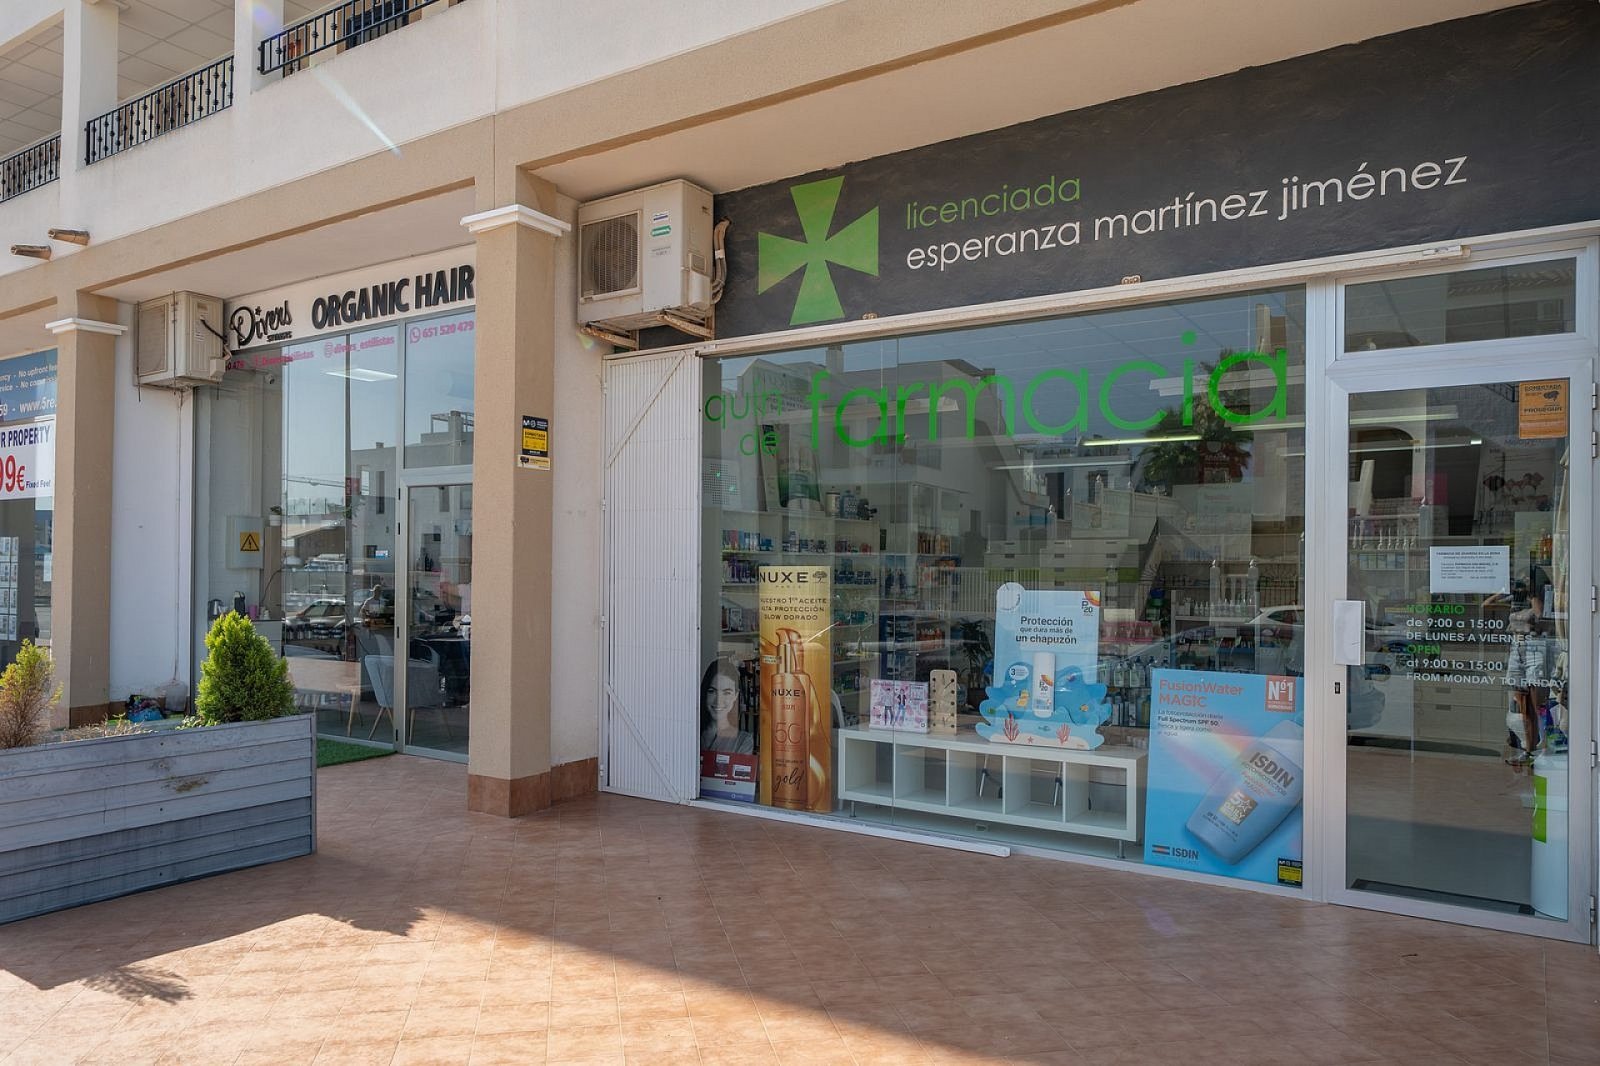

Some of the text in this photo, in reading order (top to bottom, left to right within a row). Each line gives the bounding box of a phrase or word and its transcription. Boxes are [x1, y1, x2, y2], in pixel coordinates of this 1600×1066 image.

[906, 175, 1081, 230] licenciada
[906, 155, 1468, 271] esperanza martínez jiménez
[312, 264, 476, 330] ORGANIC HAIR
[422, 326, 438, 338] 651
[806, 330, 1288, 450] farmacia
[8, 425, 50, 447] PROPERTY
[740, 424, 781, 456] de
[758, 571, 809, 584] NUXE
[1406, 604, 1465, 616] HORARIO
[1020, 614, 1074, 627] Protección
[1406, 617, 1504, 630] de 9:00 a 15:00
[1019, 626, 1032, 634] que
[1406, 631, 1533, 643] DE LUNES A VIERNES
[1015, 634, 1077, 645] un chapuzón
[1406, 644, 1441, 656] OPEN
[1406, 658, 1503, 672] at 9:00 to 15:00
[1406, 672, 1442, 682] FROM
[1444, 674, 1496, 685] MONDAY
[1501, 676, 1517, 686] TO
[771, 688, 801, 697] NUXE
[1159, 679, 1245, 696] FusionWater
[1159, 693, 1208, 708] MAGIC
[1169, 717, 1197, 725] Spectrum
[1249, 751, 1295, 789] ISDIN
[1171, 846, 1200, 861] ISDIN
